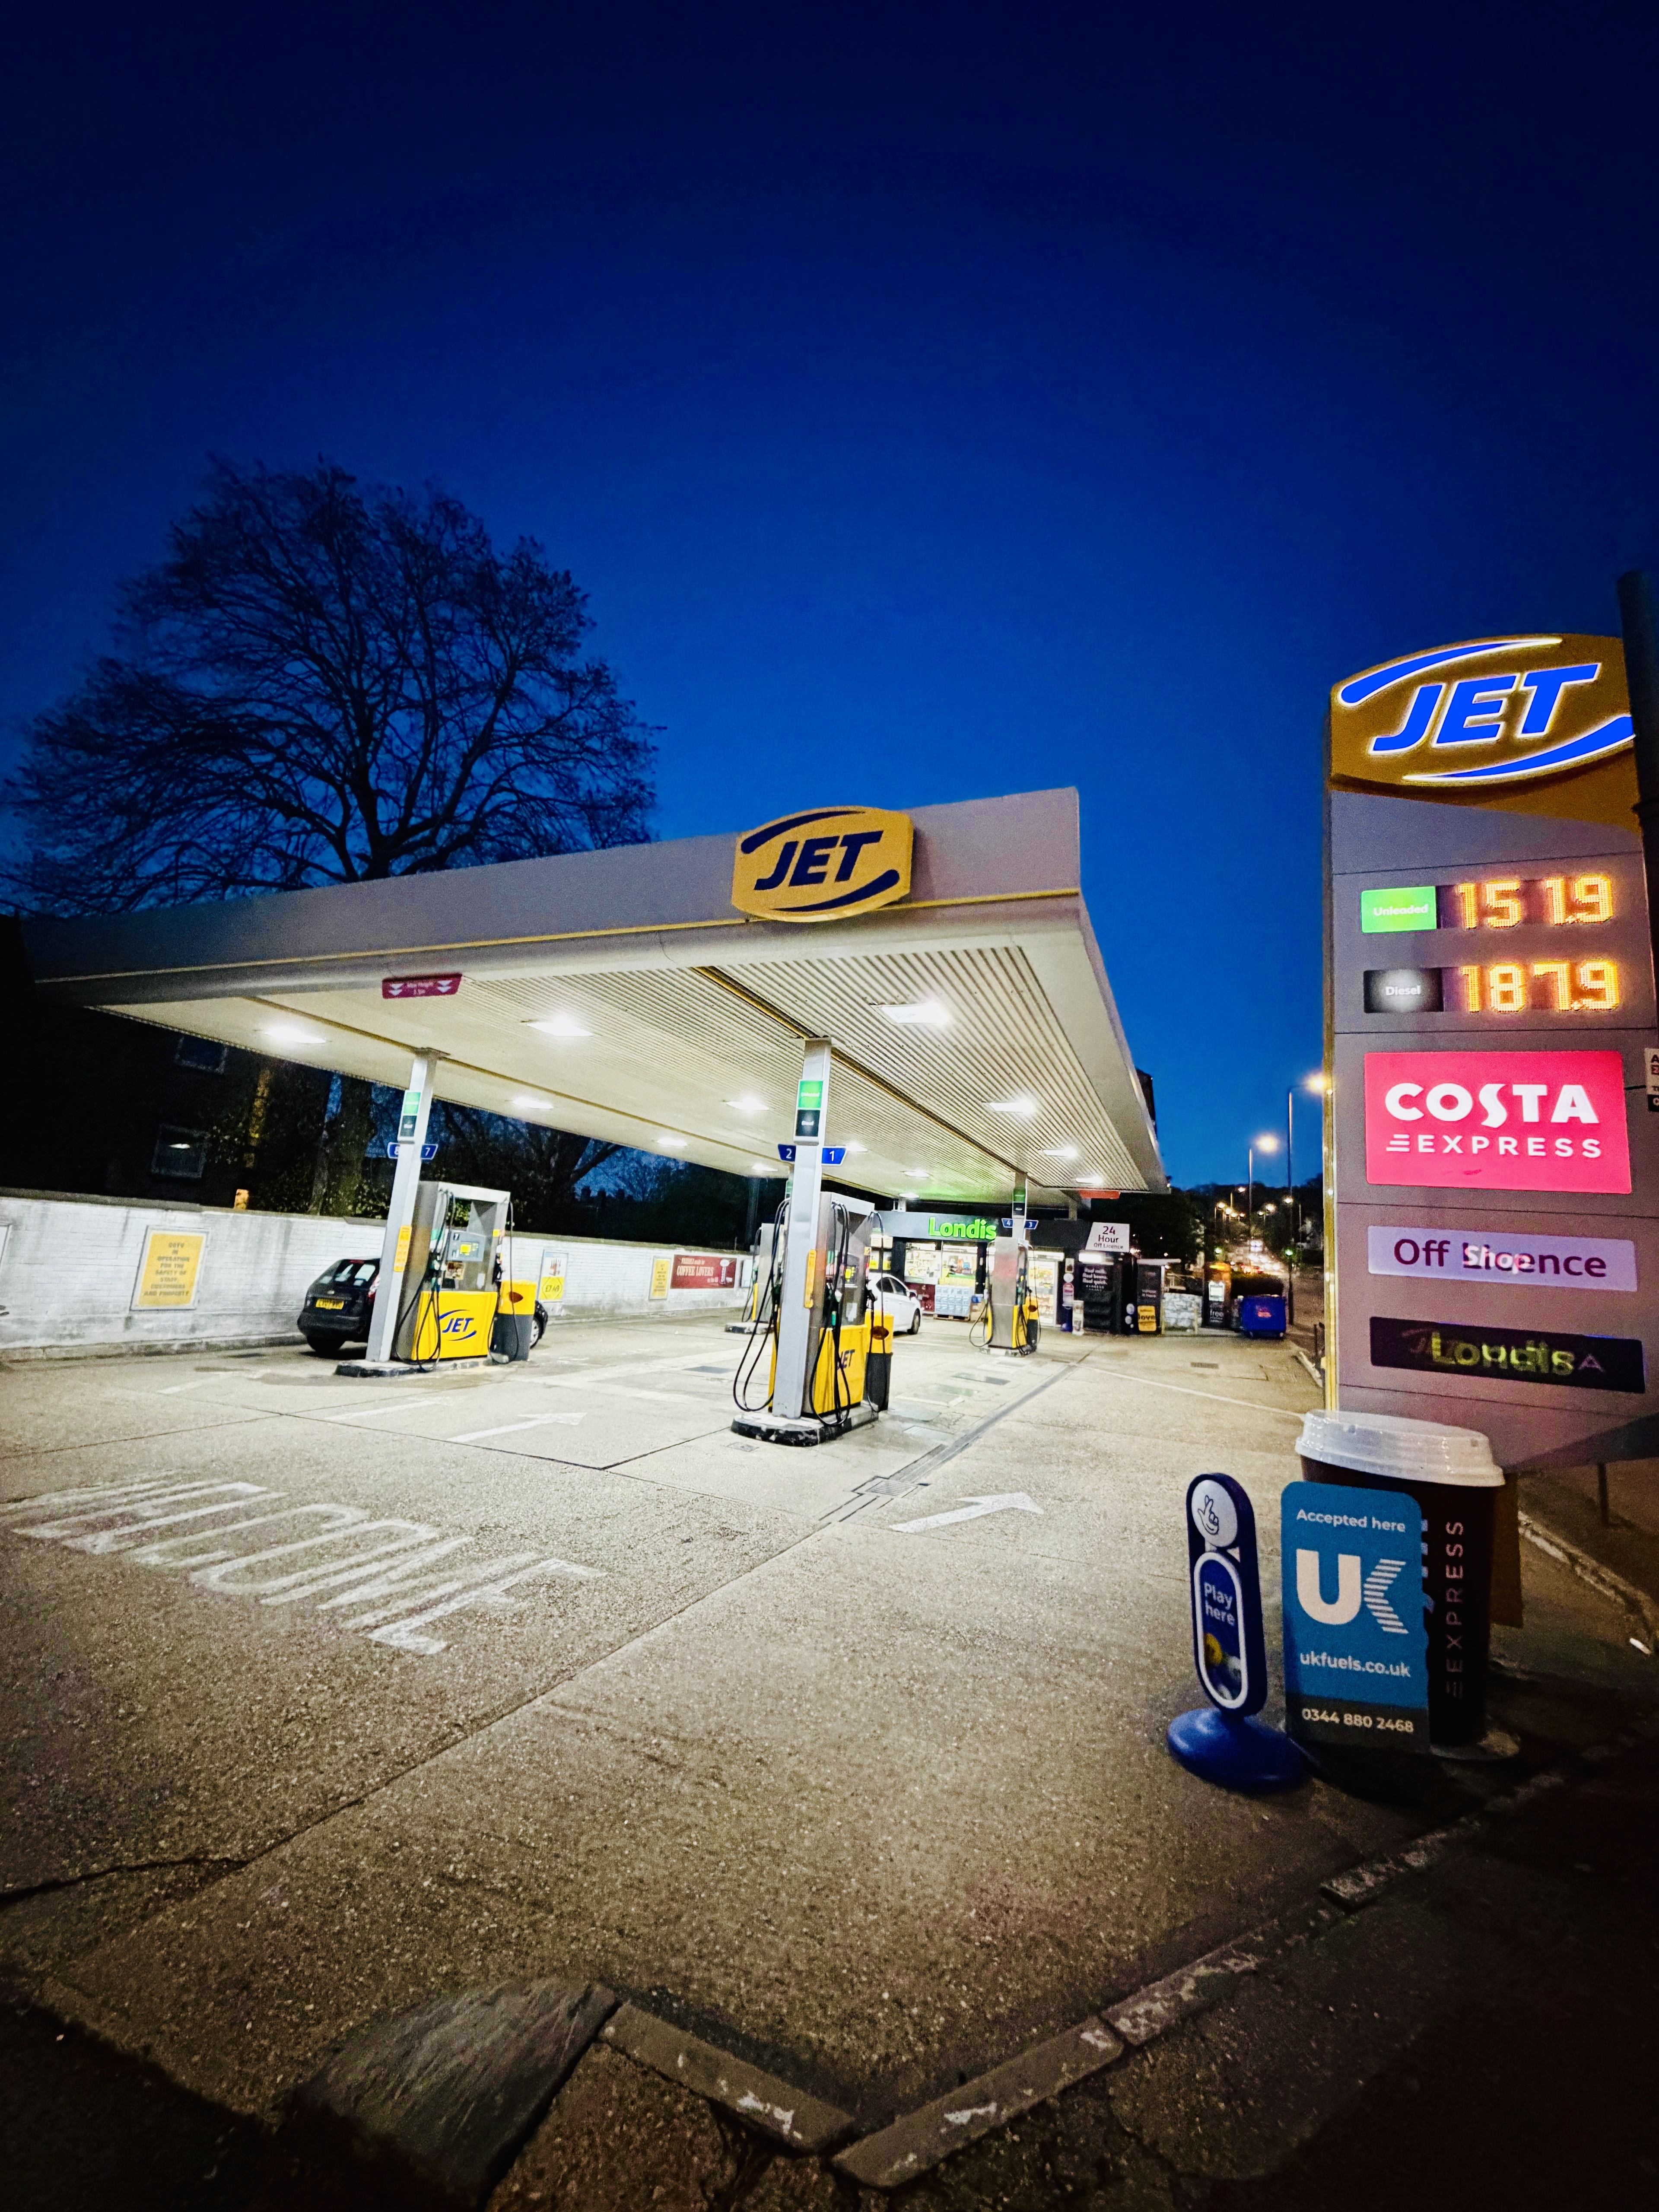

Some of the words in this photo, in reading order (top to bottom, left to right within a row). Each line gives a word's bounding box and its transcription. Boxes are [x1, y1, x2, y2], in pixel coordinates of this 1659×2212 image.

[1368, 663, 1601, 755] JET
[754, 830, 884, 890] JET
[1373, 903, 1429, 916] Unleaded
[1385, 985, 1421, 996] Diesel
[1385, 1082, 1599, 1128] COSTA
[425, 1147, 430, 1156] 7
[785, 1148, 792, 1159] 2
[829, 1150, 835, 1161] 1
[1418, 1134, 1602, 1158] EXPRESS
[929, 1216, 997, 1240] Londis
[1098, 1234, 1119, 1243] Hour
[1102, 1226, 1116, 1235] 24
[1394, 1239, 1450, 1266] Off
[677, 1265, 696, 1276] COFFEE
[696, 1266, 714, 1276] LOVERS
[442, 1318, 474, 1333] JET
[1297, 1509, 1367, 1528] Accepted
[1372, 1516, 1406, 1532] here
[1204, 1582, 1233, 1611] Play
[1296, 1548, 1409, 1634] UK
[1445, 1521, 1464, 1672] EXPRESS
[1205, 1599, 1235, 1626] here
[1300, 1650, 1411, 1677] ukfuels.co.uk
[1302, 1708, 1340, 1724] 0344
[1343, 1713, 1373, 1728] 880
[1376, 1716, 1414, 1733] 2468
